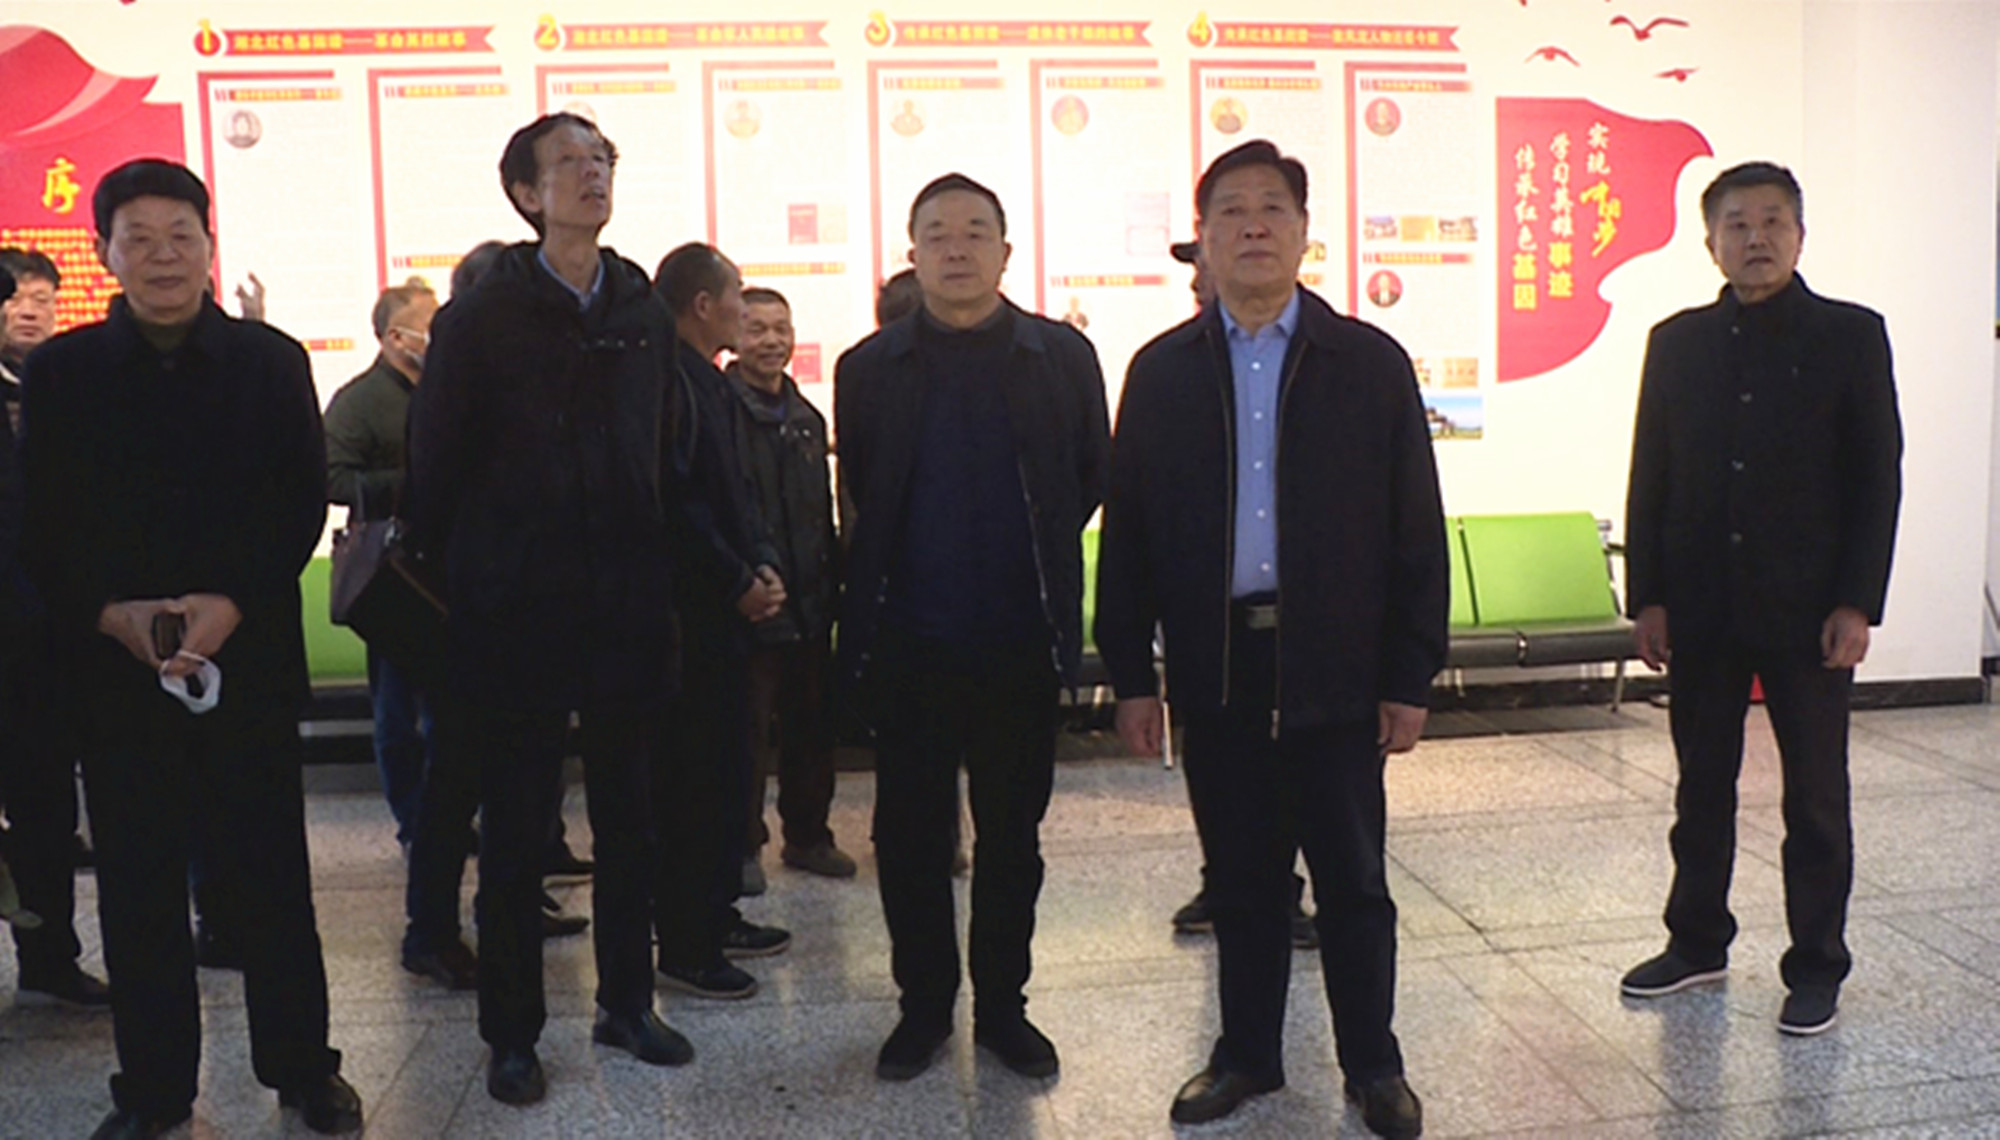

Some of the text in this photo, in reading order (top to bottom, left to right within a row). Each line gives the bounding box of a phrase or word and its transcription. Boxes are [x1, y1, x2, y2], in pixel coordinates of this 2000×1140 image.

[537, 13, 557, 46] 2
[867, 10, 888, 43] 3
[1190, 11, 1209, 42] 4
[42, 157, 81, 214] 序
[1513, 143, 1540, 310] 传承红色基因
[1549, 131, 1574, 297] 学习英雄事迹
